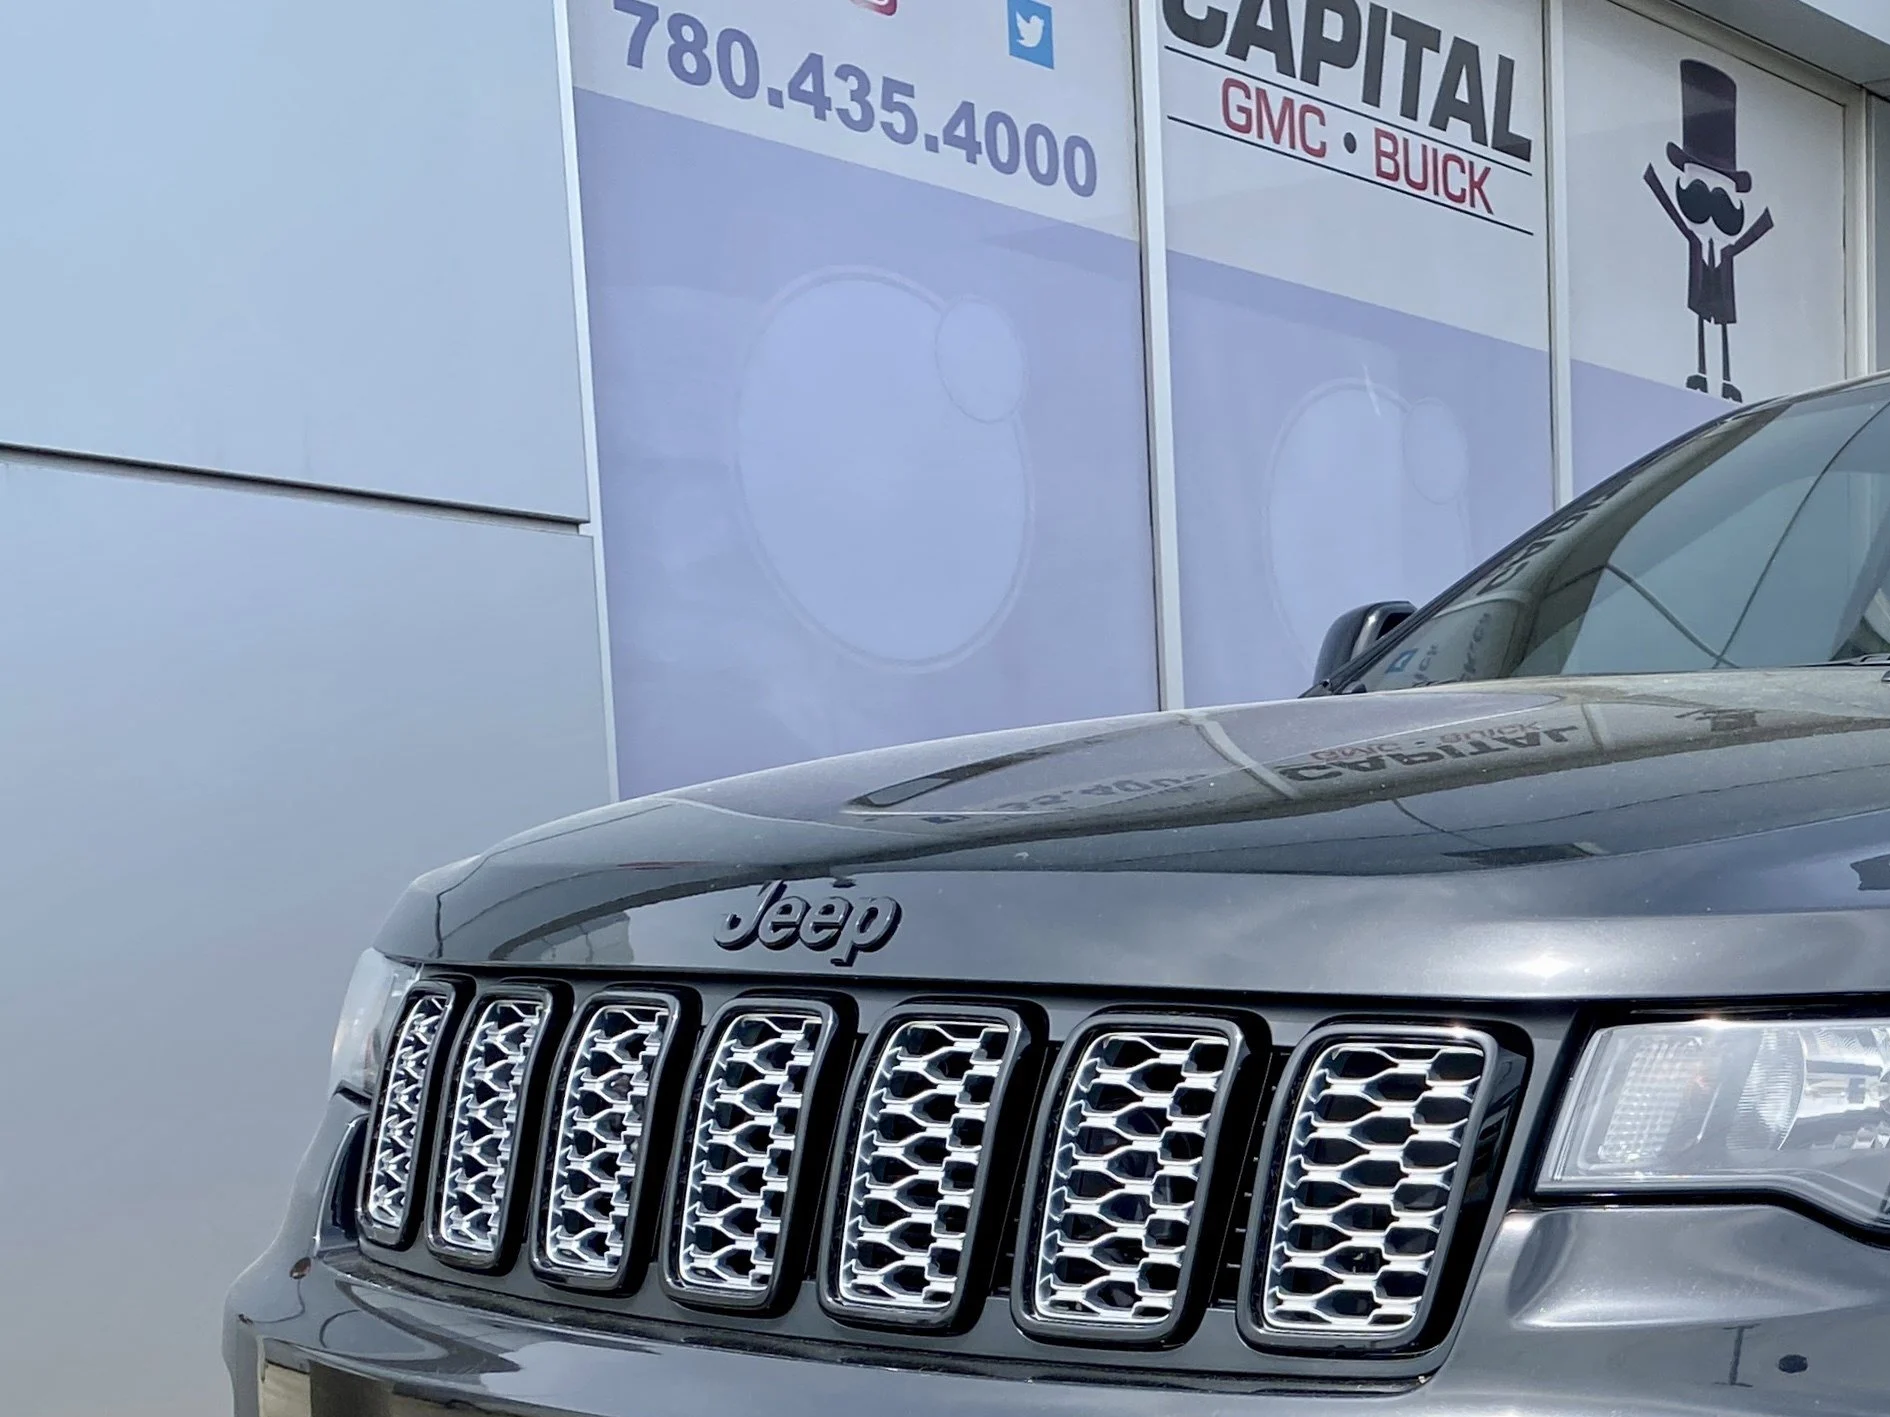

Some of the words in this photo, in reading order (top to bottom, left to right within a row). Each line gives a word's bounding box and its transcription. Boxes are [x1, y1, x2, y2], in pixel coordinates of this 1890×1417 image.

[613, 0, 1098, 198] 780.435.4000
[1221, 77, 1327, 158] GMC
[1374, 126, 1494, 215] BUICK
[713, 877, 903, 967] Jeep
